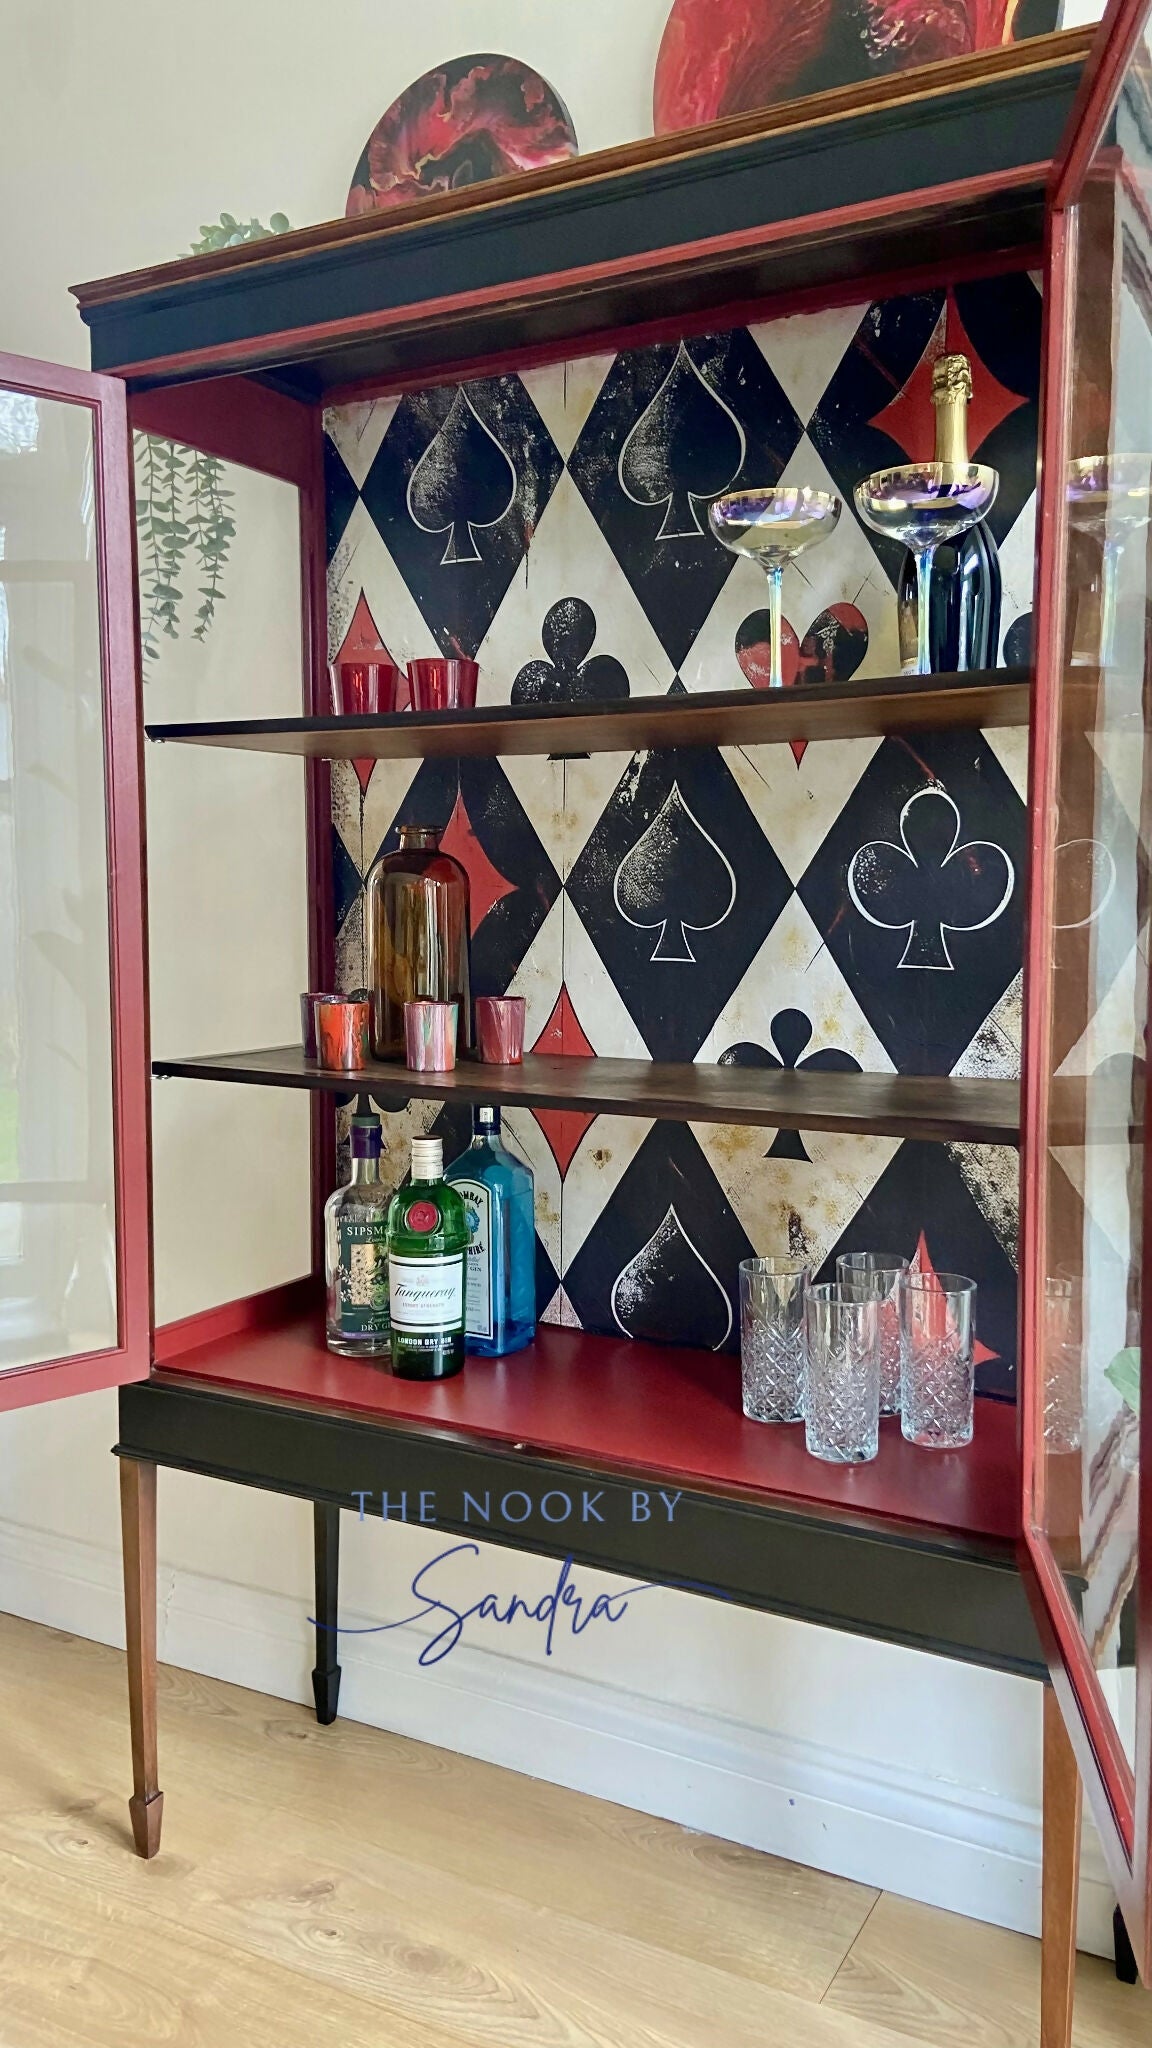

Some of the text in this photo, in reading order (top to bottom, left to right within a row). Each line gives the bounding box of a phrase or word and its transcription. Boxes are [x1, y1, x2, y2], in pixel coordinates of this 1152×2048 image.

[460, 1190, 484, 1206] MBAY
[347, 1226, 383, 1236] SIPSM
[468, 1241, 485, 1255] HIRE
[394, 1283, 456, 1302] Tanqueray
[361, 1321, 391, 1331] DRY GI
[397, 1336, 422, 1345] LONDON
